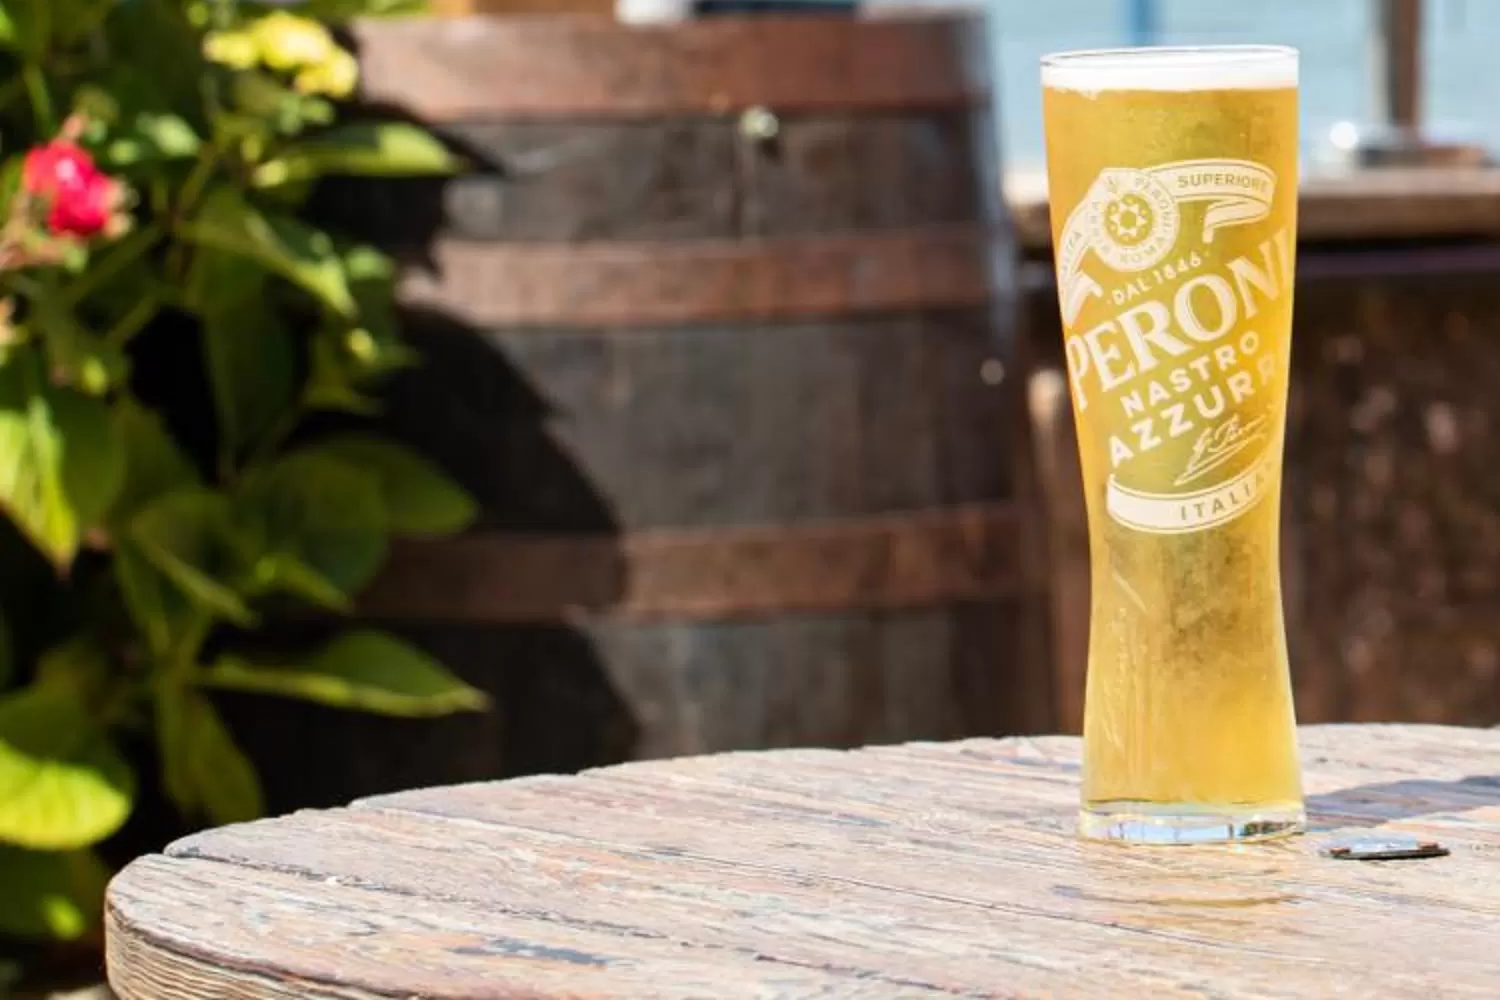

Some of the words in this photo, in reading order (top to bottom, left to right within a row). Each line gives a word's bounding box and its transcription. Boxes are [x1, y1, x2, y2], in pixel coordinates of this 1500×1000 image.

[1112, 278, 1152, 306] DAL
[1153, 250, 1202, 285] 1846
[1108, 352, 1277, 468] AZZURR
[1119, 331, 1260, 419] NASTRO
